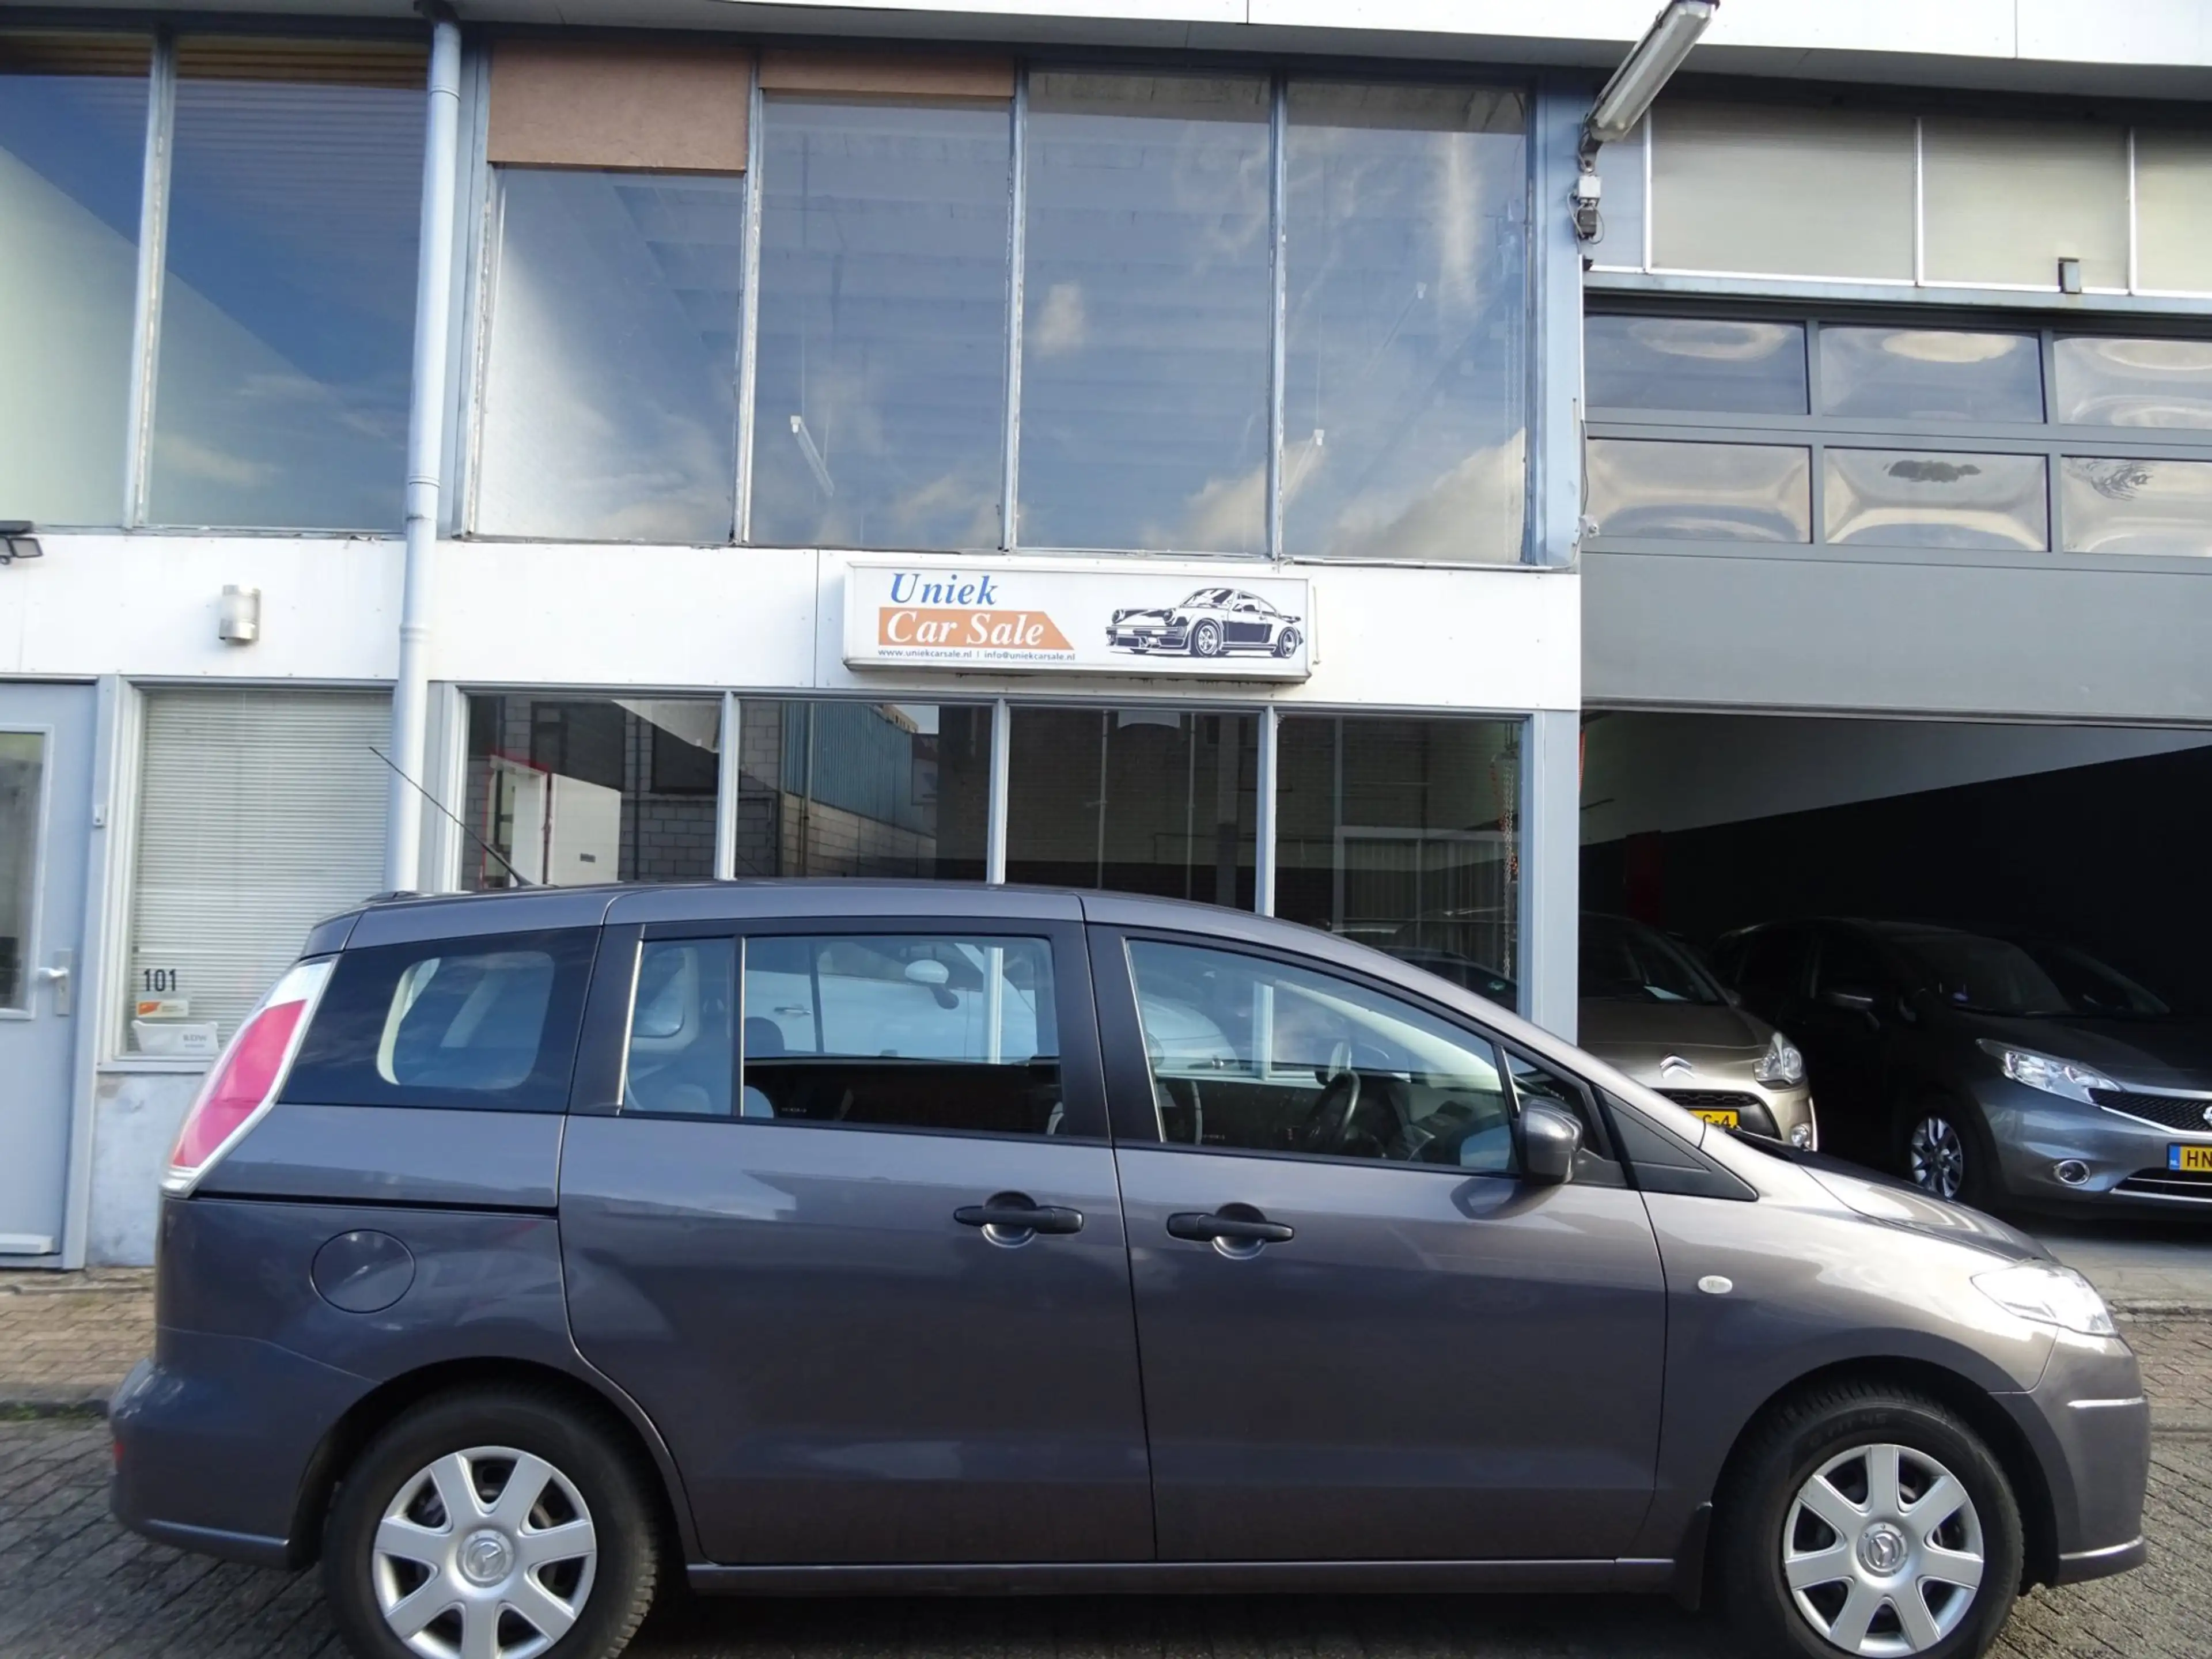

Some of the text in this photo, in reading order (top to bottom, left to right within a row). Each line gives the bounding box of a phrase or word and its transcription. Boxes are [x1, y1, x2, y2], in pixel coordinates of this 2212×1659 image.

[891, 573, 999, 605] Uniek
[887, 611, 1044, 646] Car Sale
[878, 649, 972, 658] www.uniekcarsale.nl
[984, 650, 1076, 661] info@uniekcarsale.nl
[144, 968, 176, 992] 101
